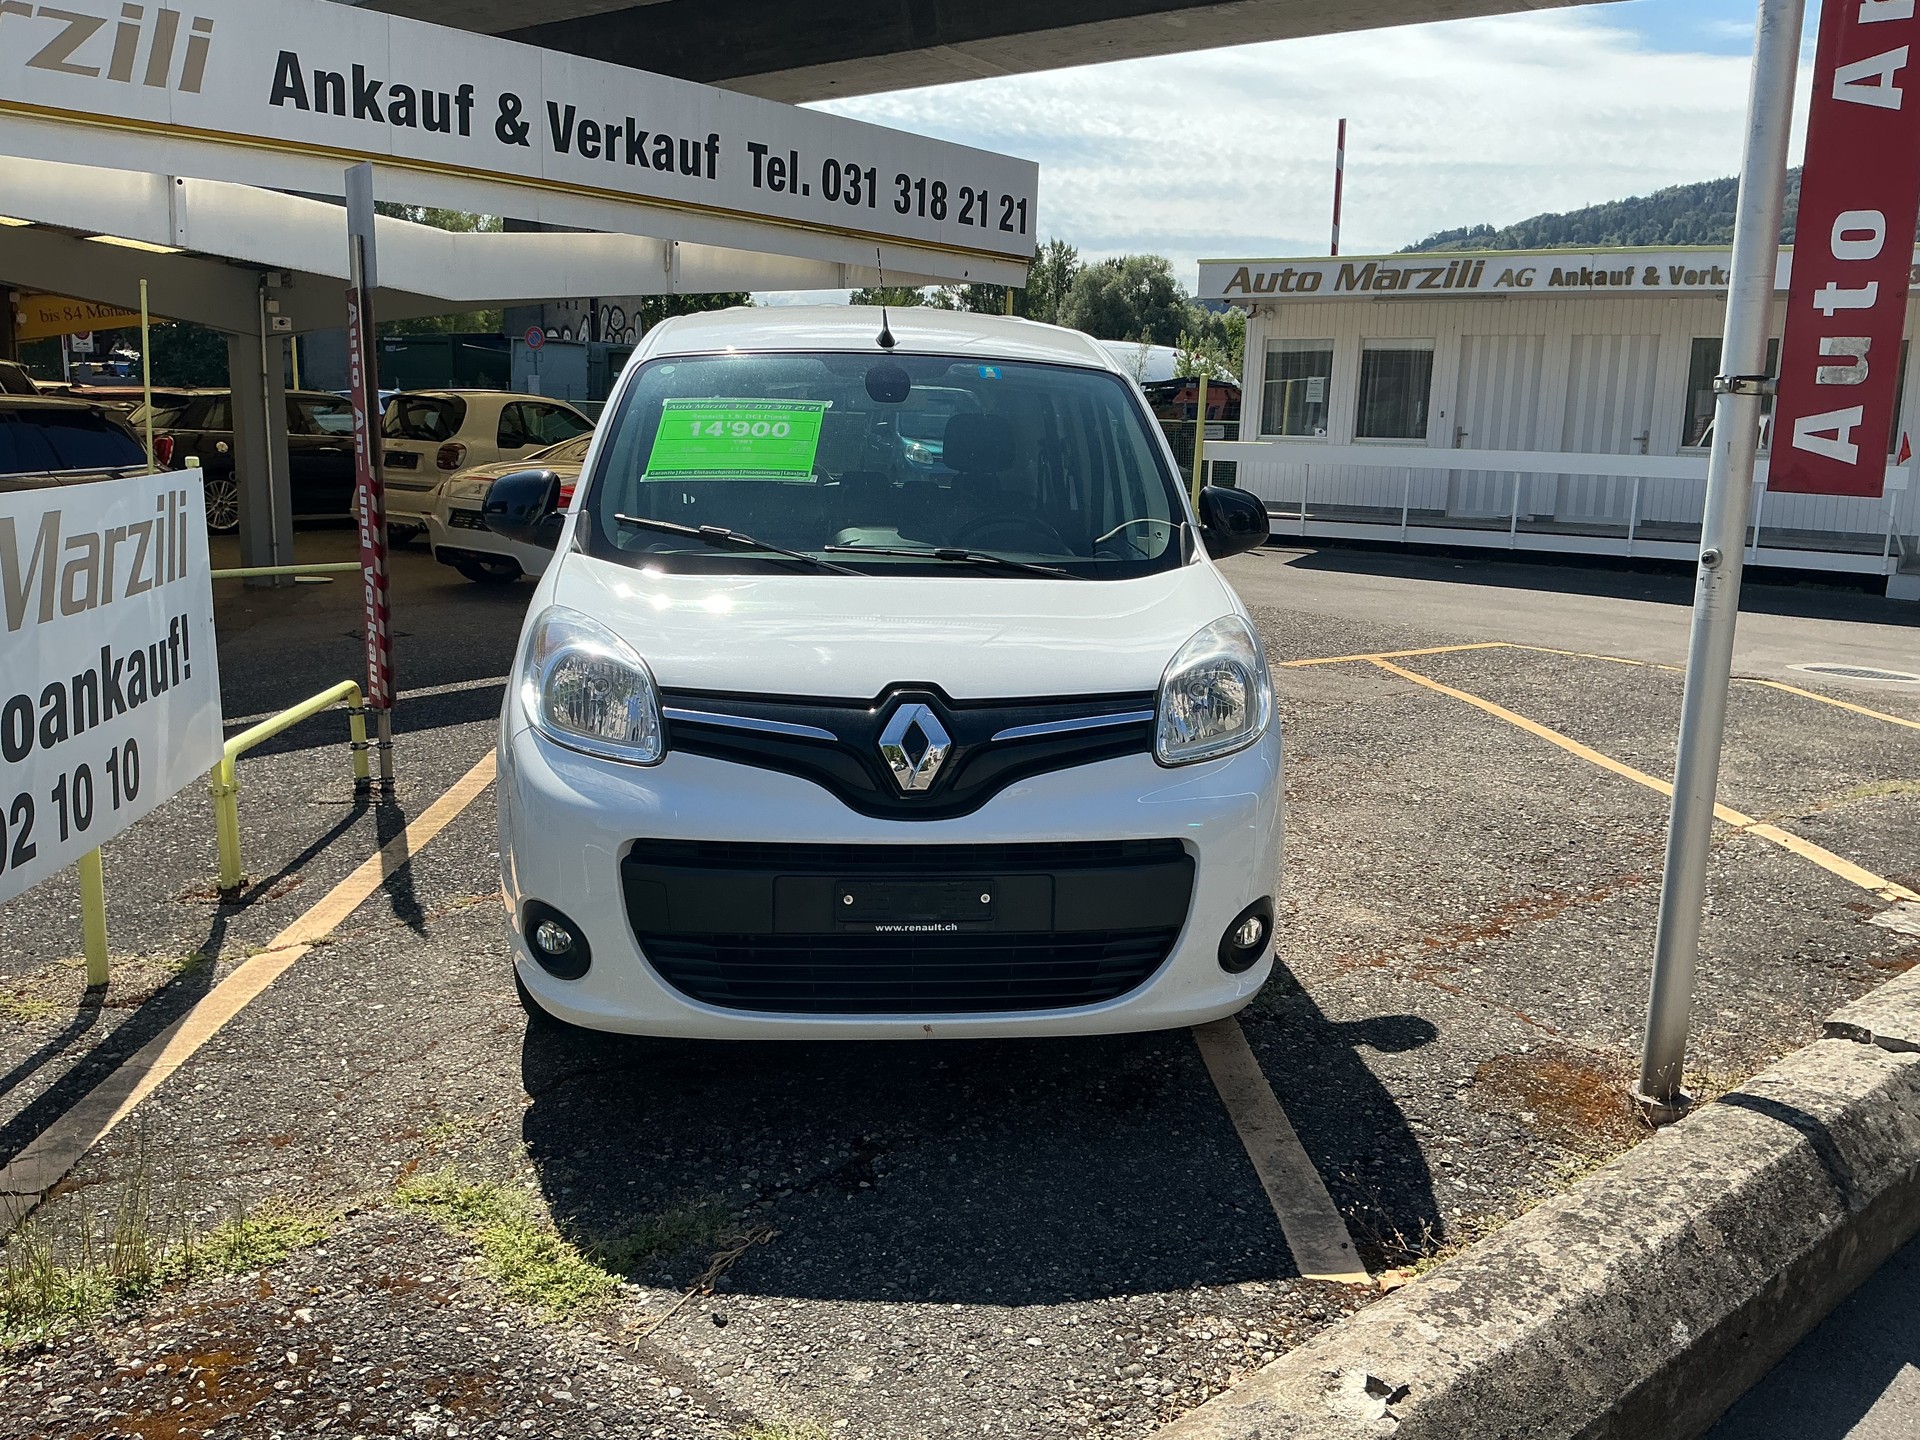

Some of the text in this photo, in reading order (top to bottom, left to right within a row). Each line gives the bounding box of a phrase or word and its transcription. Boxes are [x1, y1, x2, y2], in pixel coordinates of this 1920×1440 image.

[269, 50, 1028, 235] Ankauf & Verkauf Tel. 031 318 21 21
[39, 308, 61, 323] bis
[63, 306, 82, 320] 84
[1222, 267, 1322, 294] Auto
[1334, 260, 1485, 291] Marzili
[1493, 268, 1536, 287] AG
[1548, 266, 1634, 286] Ankauf
[1642, 266, 1660, 286] &
[348, 302, 360, 388] Auto
[1792, 209, 1887, 465] Auto
[690, 421, 791, 438] 14'900
[359, 485, 372, 549] und
[0, 490, 187, 632] Marzili
[364, 566, 381, 701] Verkauf
[51, 763, 94, 843] 10
[106, 738, 140, 811] 10
[875, 923, 958, 931] www.renault.ch
